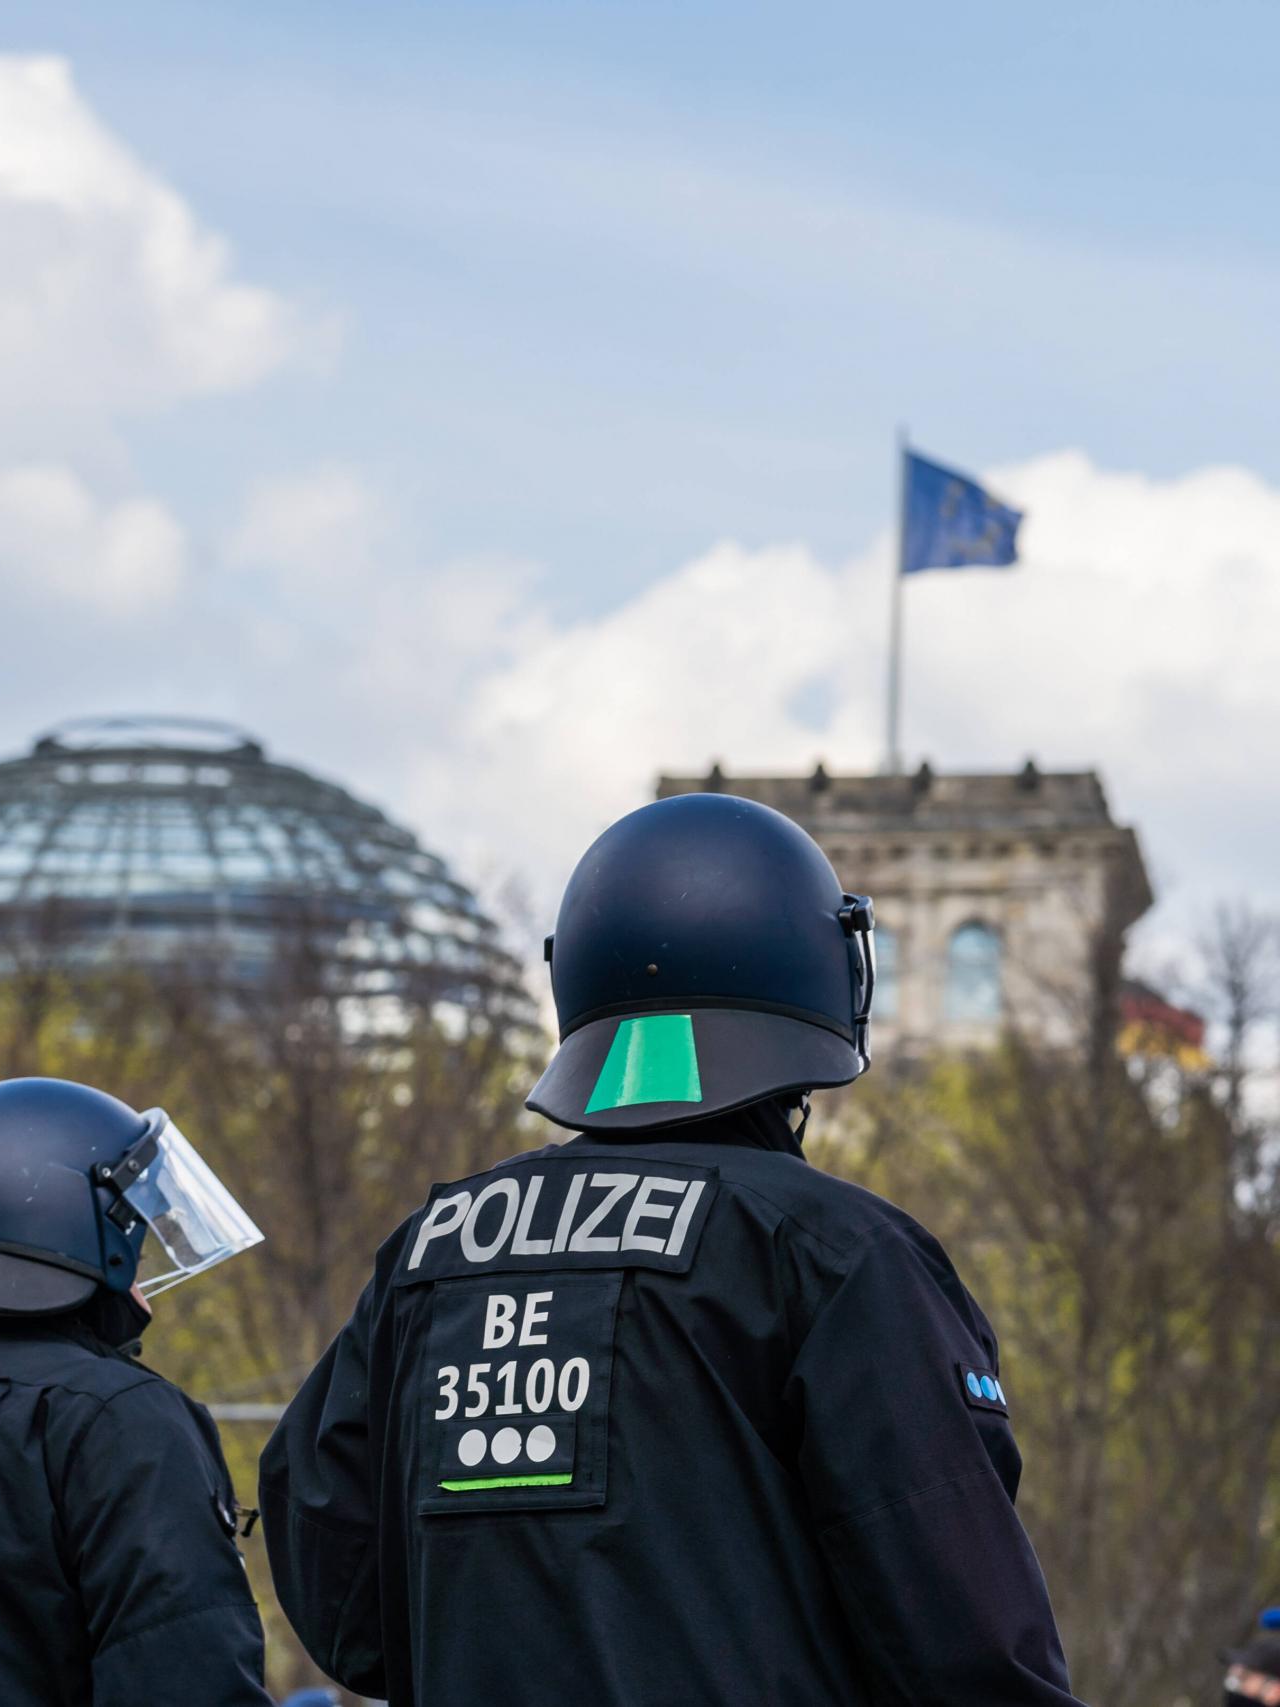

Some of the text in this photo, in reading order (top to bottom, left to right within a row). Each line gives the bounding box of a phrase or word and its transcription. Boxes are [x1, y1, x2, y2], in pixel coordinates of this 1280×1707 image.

[407, 1173, 707, 1271] POLIZEI
[482, 1291, 553, 1350] BE
[435, 1357, 590, 1420] 35100
